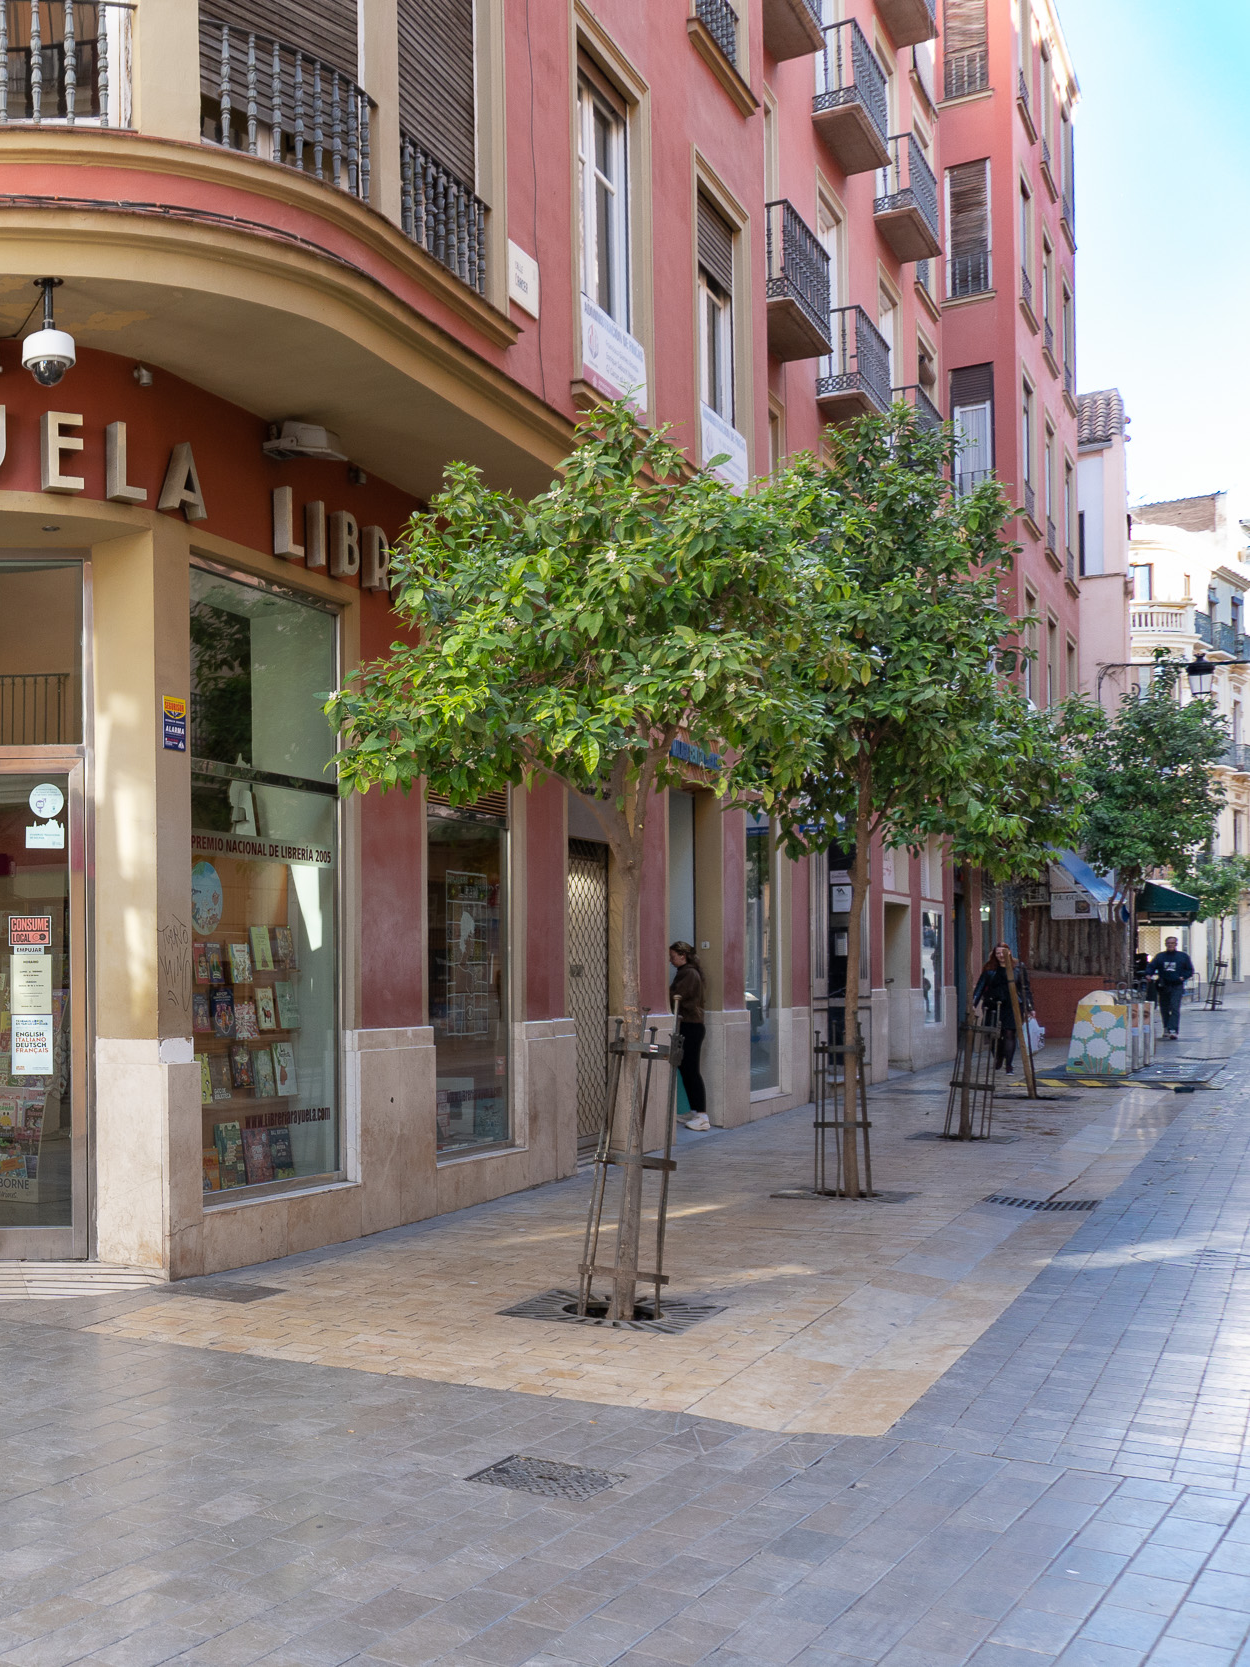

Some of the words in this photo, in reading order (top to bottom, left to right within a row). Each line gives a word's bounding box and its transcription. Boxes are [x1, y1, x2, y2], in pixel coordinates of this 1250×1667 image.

[273, 486, 390, 592] LIBR
[165, 725, 185, 735] ALARMA
[191, 835, 224, 851] PREMIO
[226, 839, 267, 856] NACIONAL
[269, 844, 279, 858] DE
[281, 845, 313, 862] LIBRERÍA
[315, 849, 332, 864] 2005
[11, 917, 49, 931] CONSUME
[12, 933, 31, 943] LOCAL
